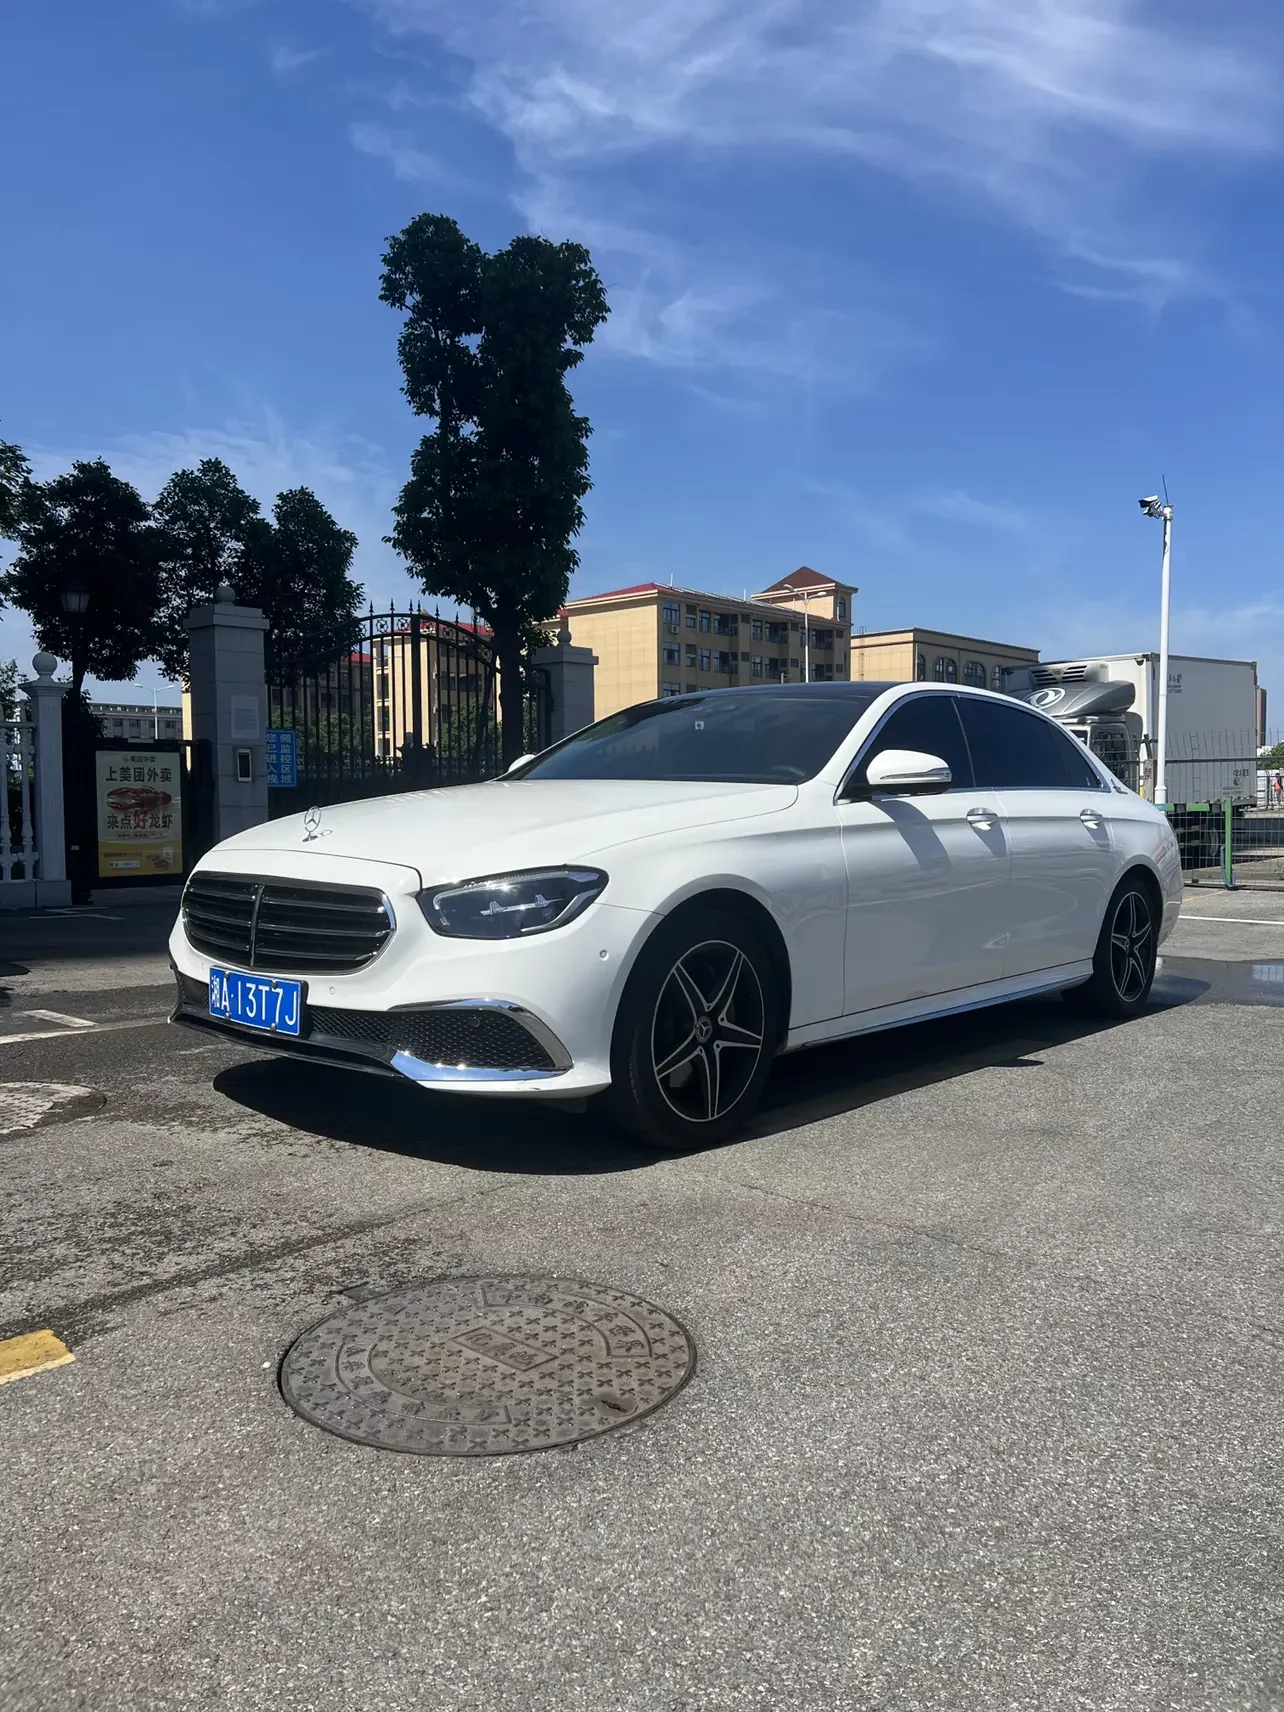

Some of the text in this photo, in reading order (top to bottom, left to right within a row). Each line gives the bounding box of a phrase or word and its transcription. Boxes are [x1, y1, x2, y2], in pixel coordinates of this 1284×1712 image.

[280, 733, 292, 784] 频监控区域
[106, 766, 172, 782] 上美团外卖
[107, 811, 174, 830] 来点好龙虾
